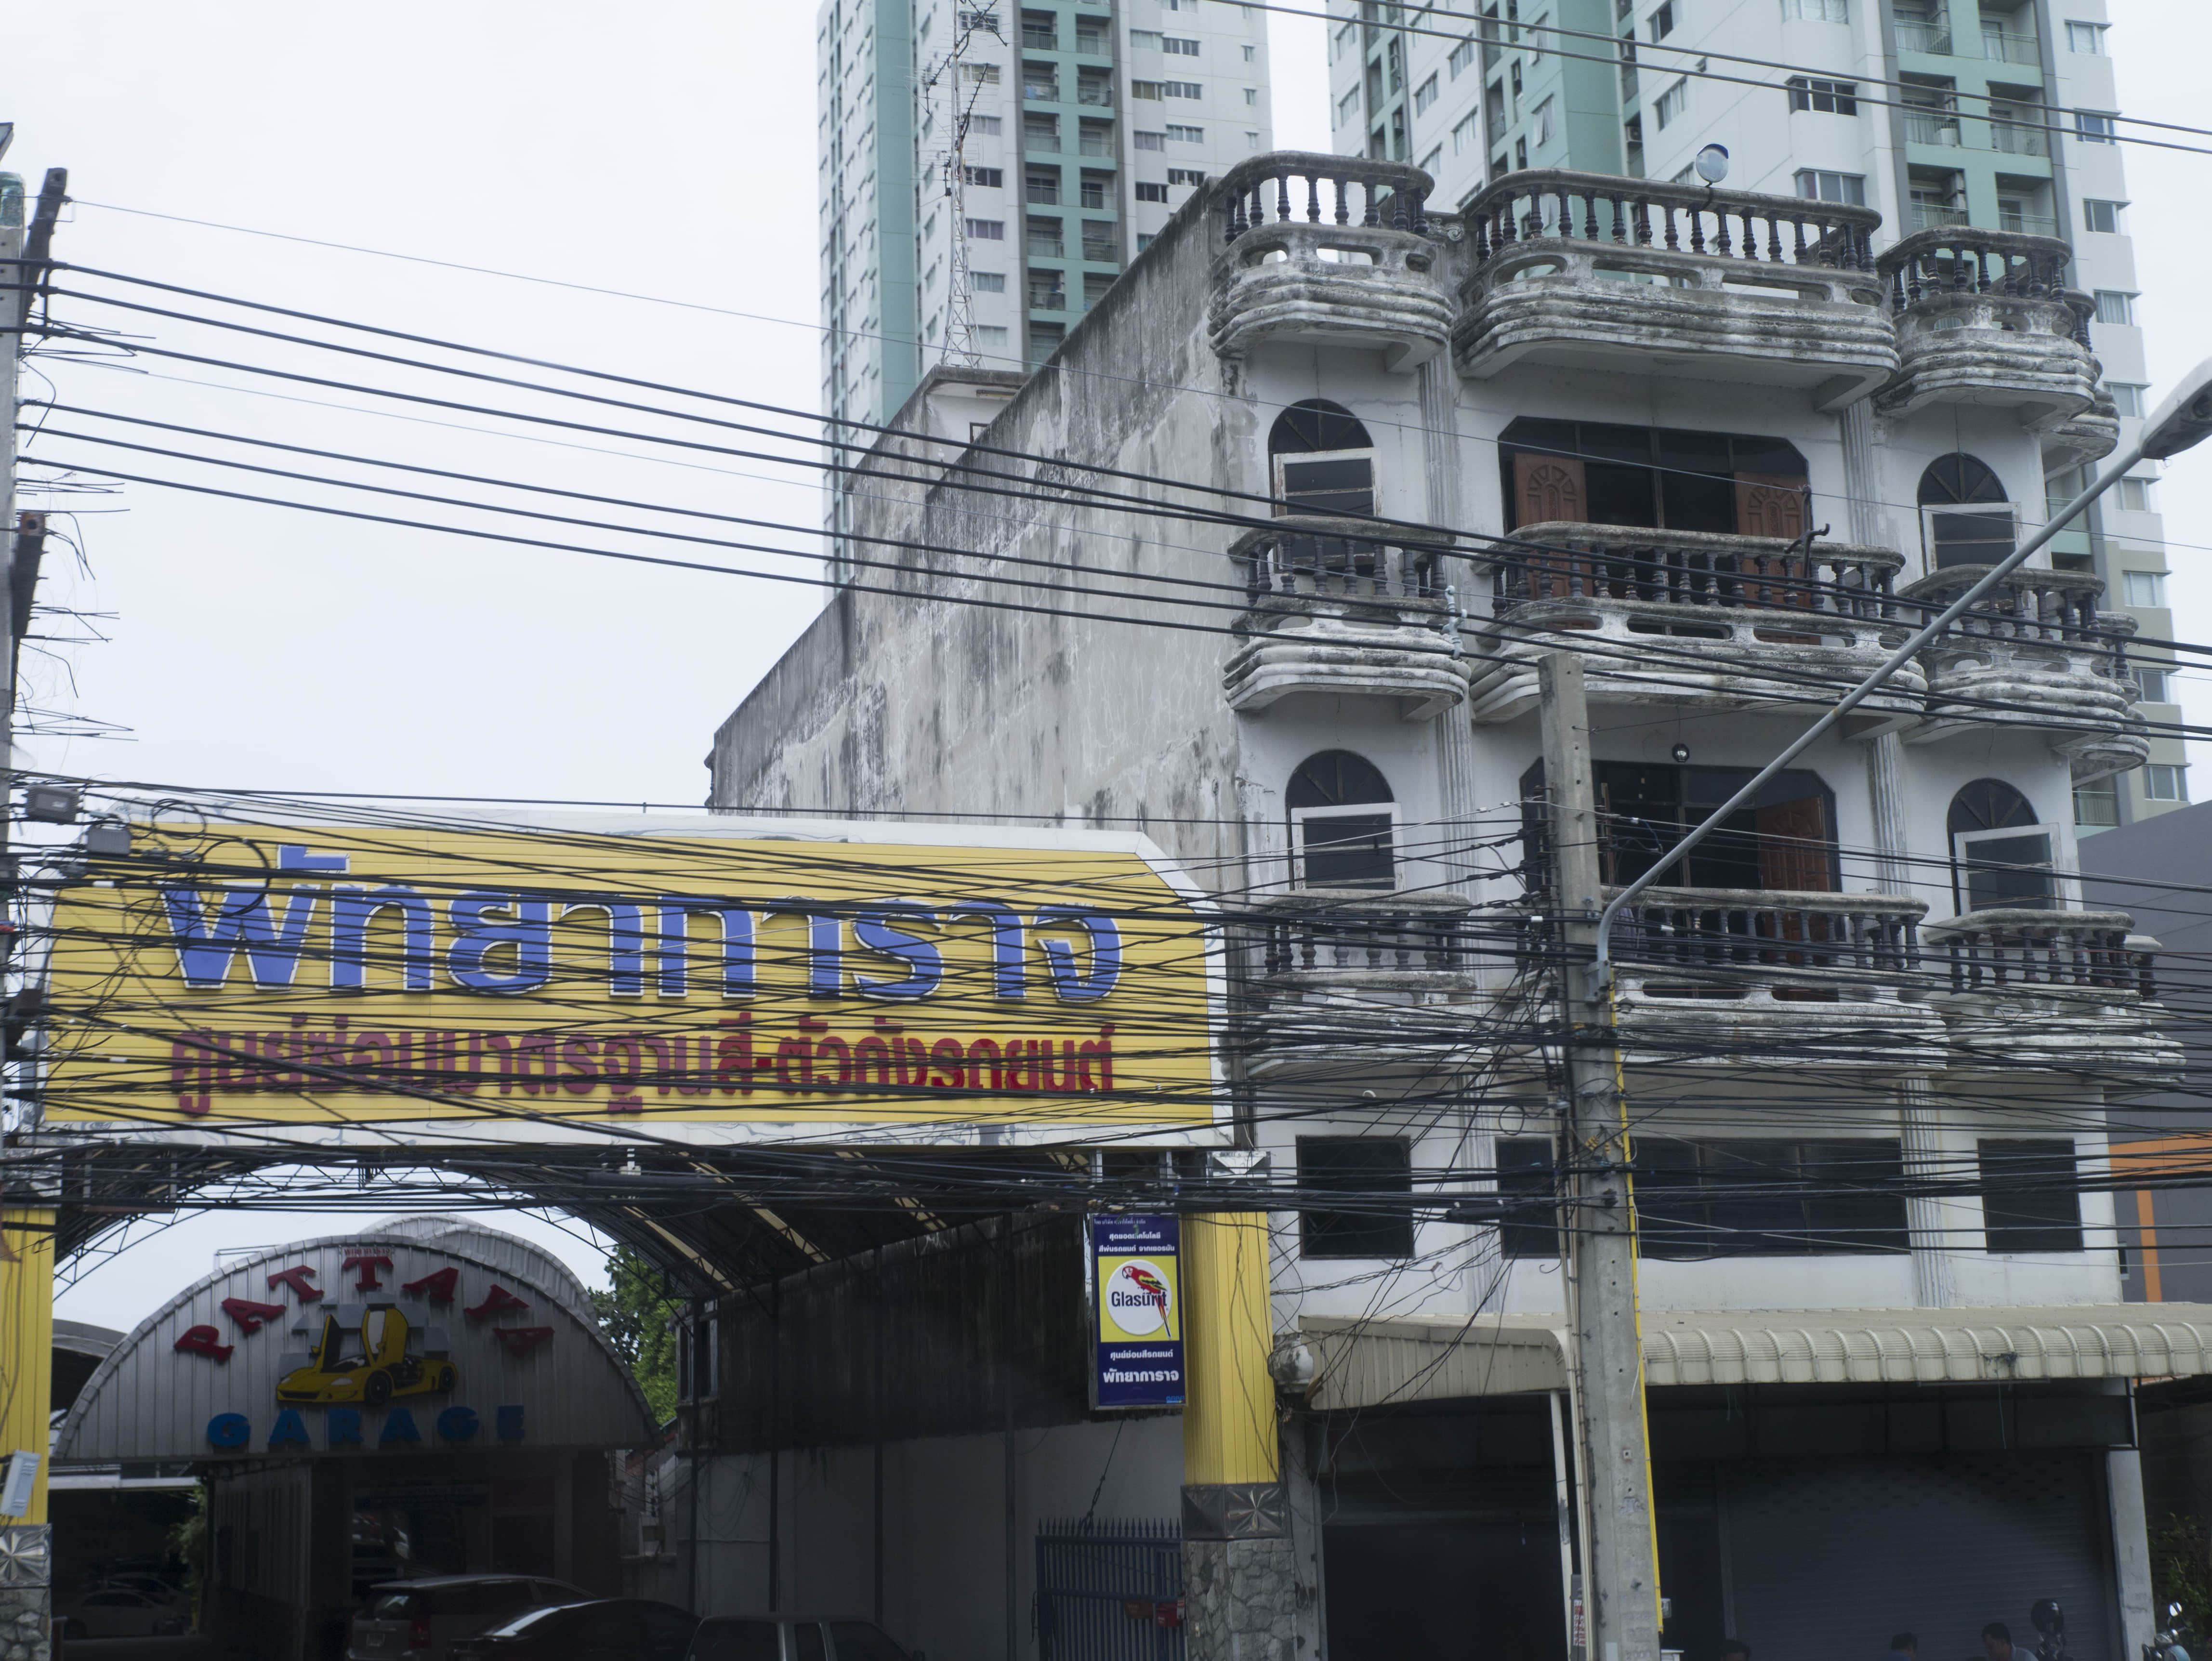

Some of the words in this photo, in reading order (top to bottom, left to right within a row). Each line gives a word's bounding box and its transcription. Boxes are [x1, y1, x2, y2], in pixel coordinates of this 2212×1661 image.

[158, 844, 1123, 1003] พัทยาการาจ
[174, 1255, 554, 1362] PATTAYA
[1111, 1291, 1167, 1307] Glasurit
[1103, 1368, 1180, 1384] พัทยาการาจ
[207, 1405, 527, 1447] GARAGE
